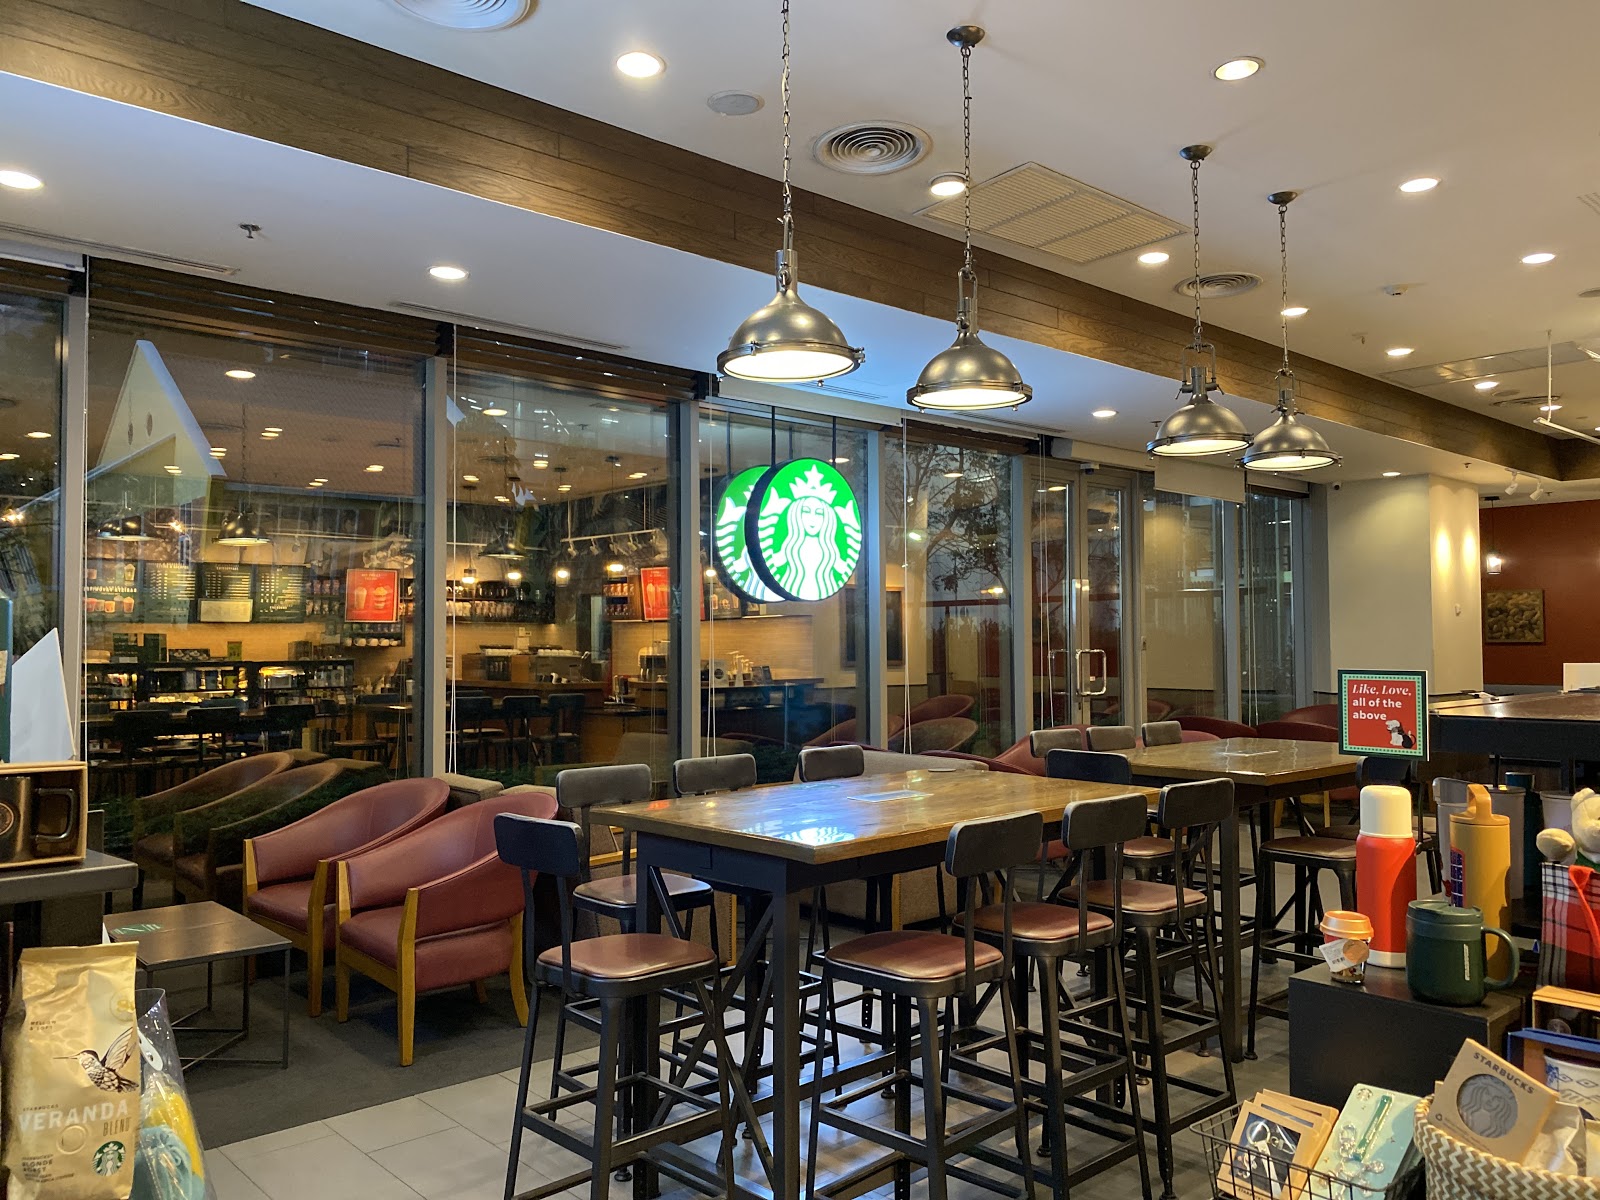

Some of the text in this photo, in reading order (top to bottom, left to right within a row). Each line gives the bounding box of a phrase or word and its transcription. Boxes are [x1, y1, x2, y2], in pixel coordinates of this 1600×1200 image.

[1352, 684, 1412, 696] Like, Love,
[1352, 697, 1403, 709] all of the
[1352, 710, 1387, 721] above
[1473, 1051, 1535, 1095] STARBUCKS
[18, 1099, 129, 1132] VERANDA
[103, 1117, 132, 1137] BLEND
